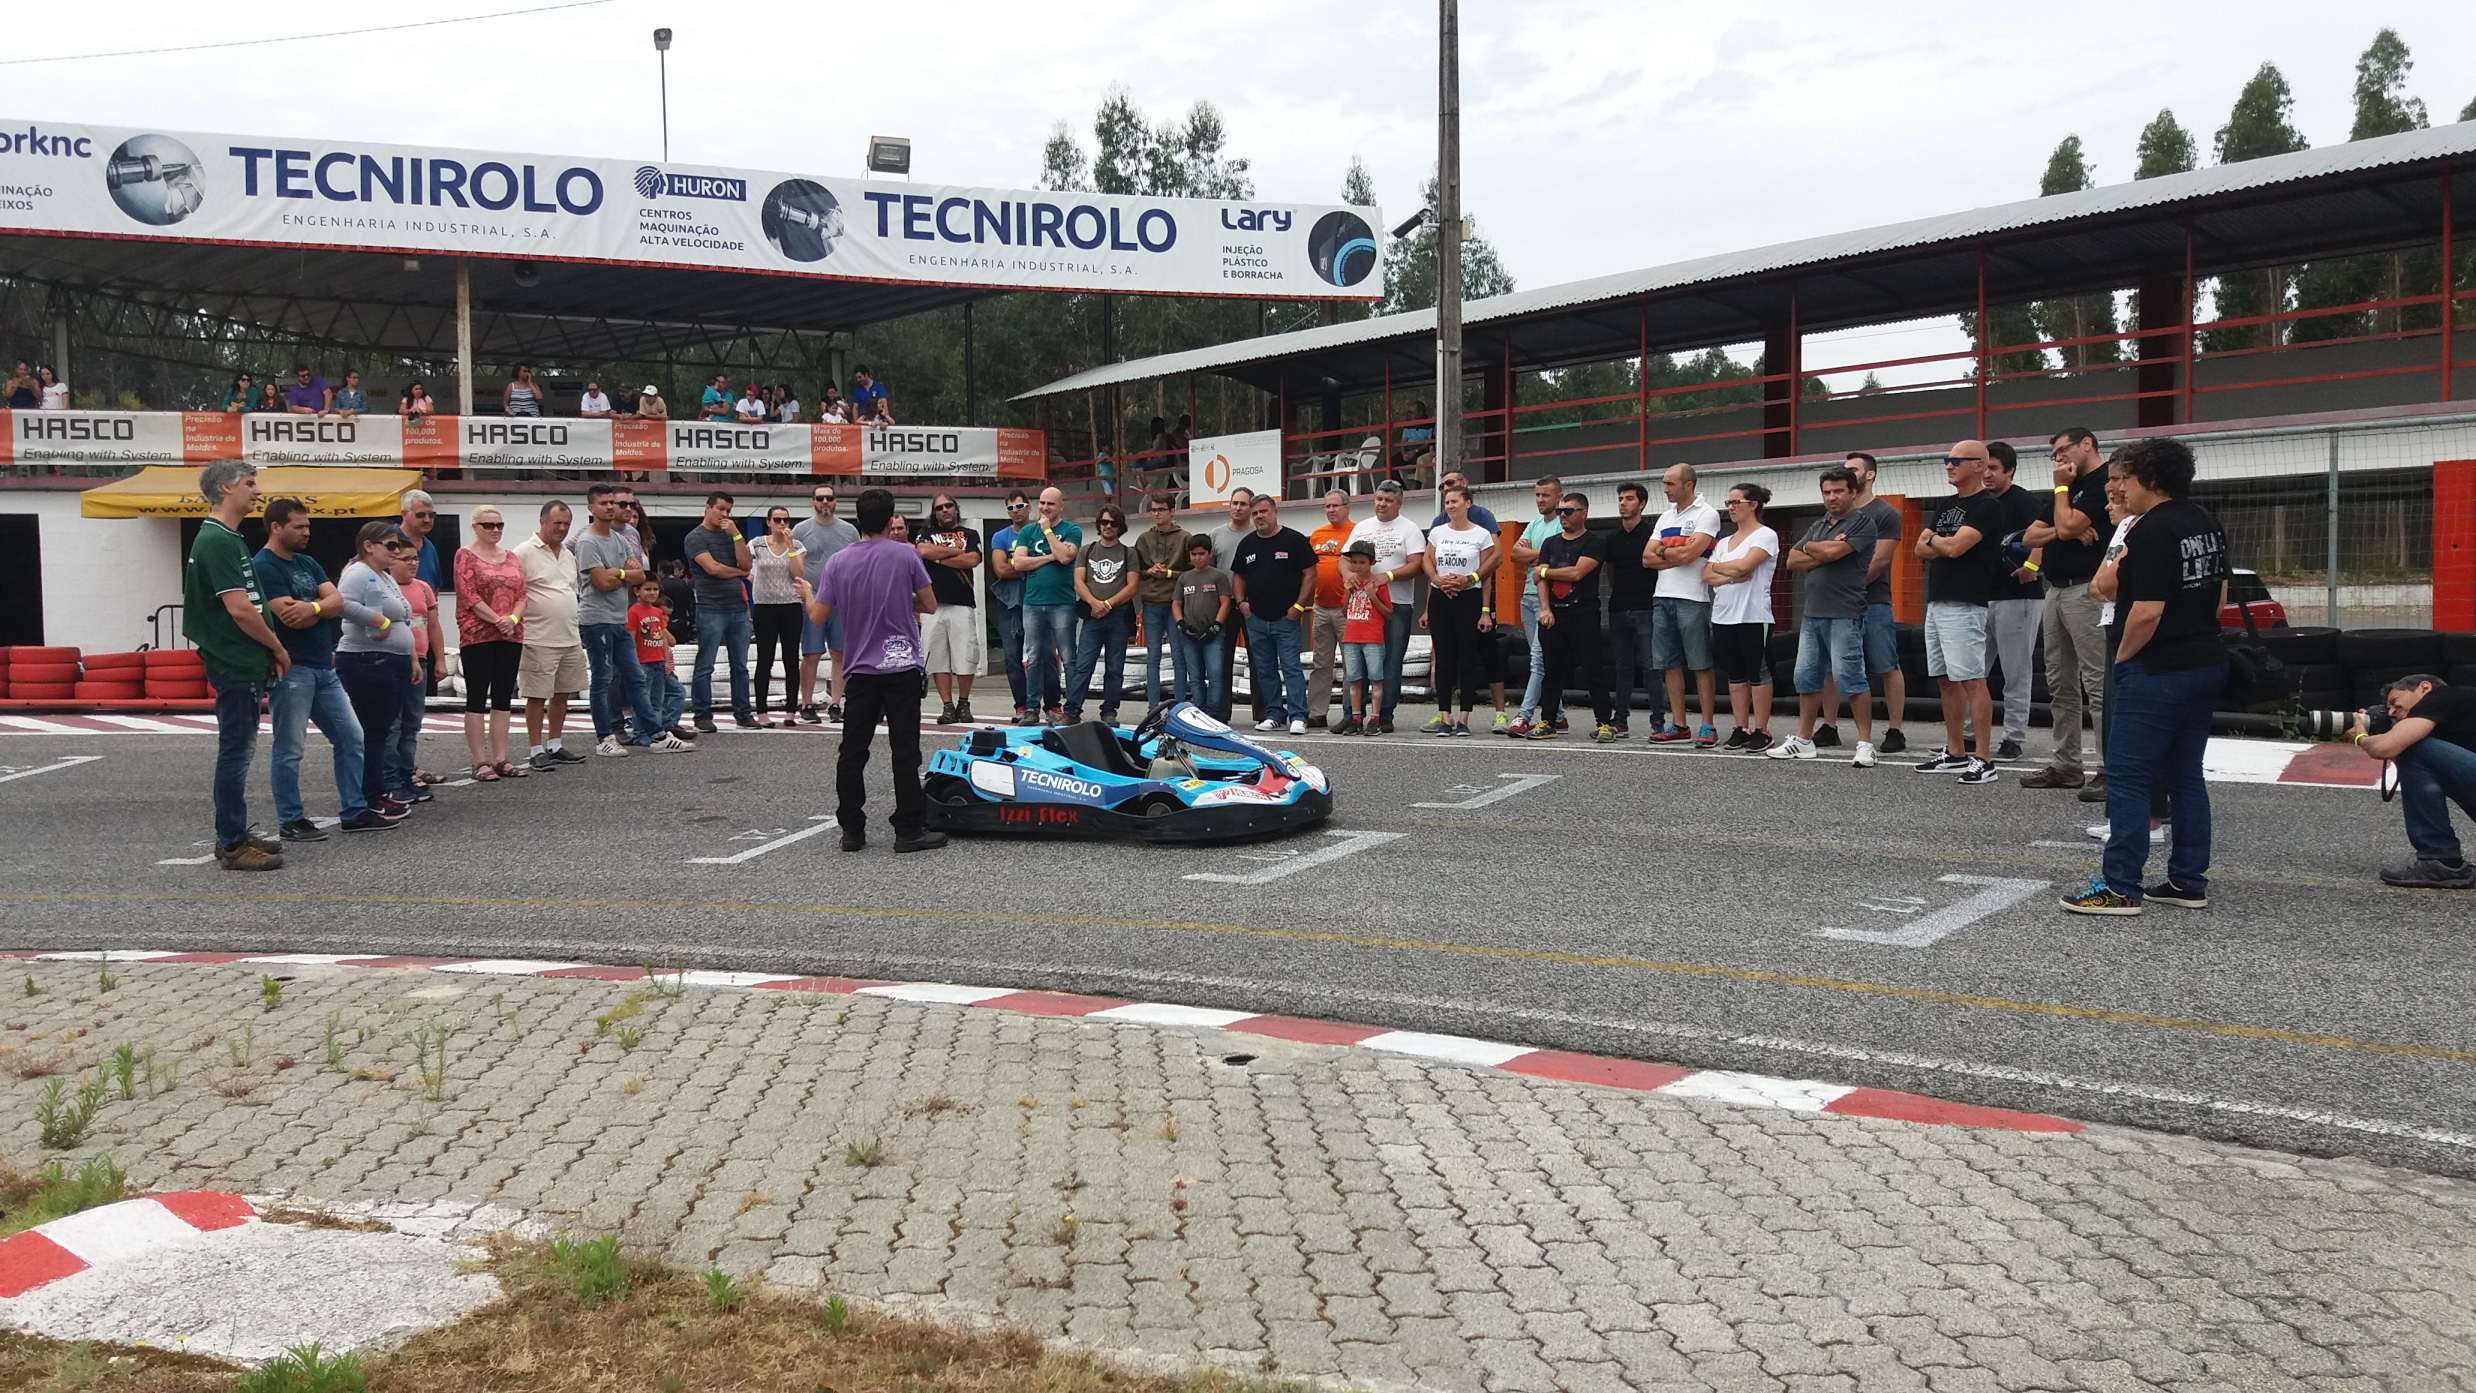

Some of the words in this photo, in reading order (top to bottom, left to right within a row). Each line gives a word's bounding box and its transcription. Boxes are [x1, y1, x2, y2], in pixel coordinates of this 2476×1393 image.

[229, 146, 604, 215] TECNIROLO
[673, 179, 740, 199] HURON
[639, 208, 693, 221] CENTROS
[864, 191, 1177, 252] TECNIROLO
[283, 214, 396, 231] ENGENHARIA
[405, 220, 515, 238] INDUSTRIAL,
[523, 227, 556, 240] S.A.
[639, 221, 719, 236] MAQUINAÇÃO
[639, 235, 670, 246] ALTA
[672, 237, 745, 251] VELOCIDADE
[1222, 244, 1263, 256] INJEÇÃO
[908, 253, 1005, 269] ENGENHARIA
[1012, 260, 1104, 275] INDUSTRIAL,
[1110, 263, 1139, 275] S.A.
[1222, 256, 1268, 268] PLÁSTICO
[1223, 270, 1229, 279] E
[1230, 270, 1284, 280] BORRACHA
[23, 418, 134, 441] HASCO
[252, 421, 356, 443] HASCO
[468, 424, 568, 446] HASCO
[675, 428, 770, 449] HASCO
[870, 432, 959, 453] HASCO
[24, 448, 84, 462] Enabling
[88, 449, 117, 461] with
[252, 449, 309, 464] Enabling
[313, 450, 340, 463] with
[469, 453, 524, 467] Enabling
[527, 453, 553, 465] with
[556, 454, 606, 467] System.
[676, 456, 728, 470] Enabling
[731, 457, 755, 469] with
[758, 458, 805, 470] System.
[871, 459, 919, 473] Enabling
[922, 460, 945, 472] with
[948, 461, 991, 473] System.
[1232, 466, 1264, 477] PRAGOSA
[1021, 769, 1102, 798] TECNIROLO
